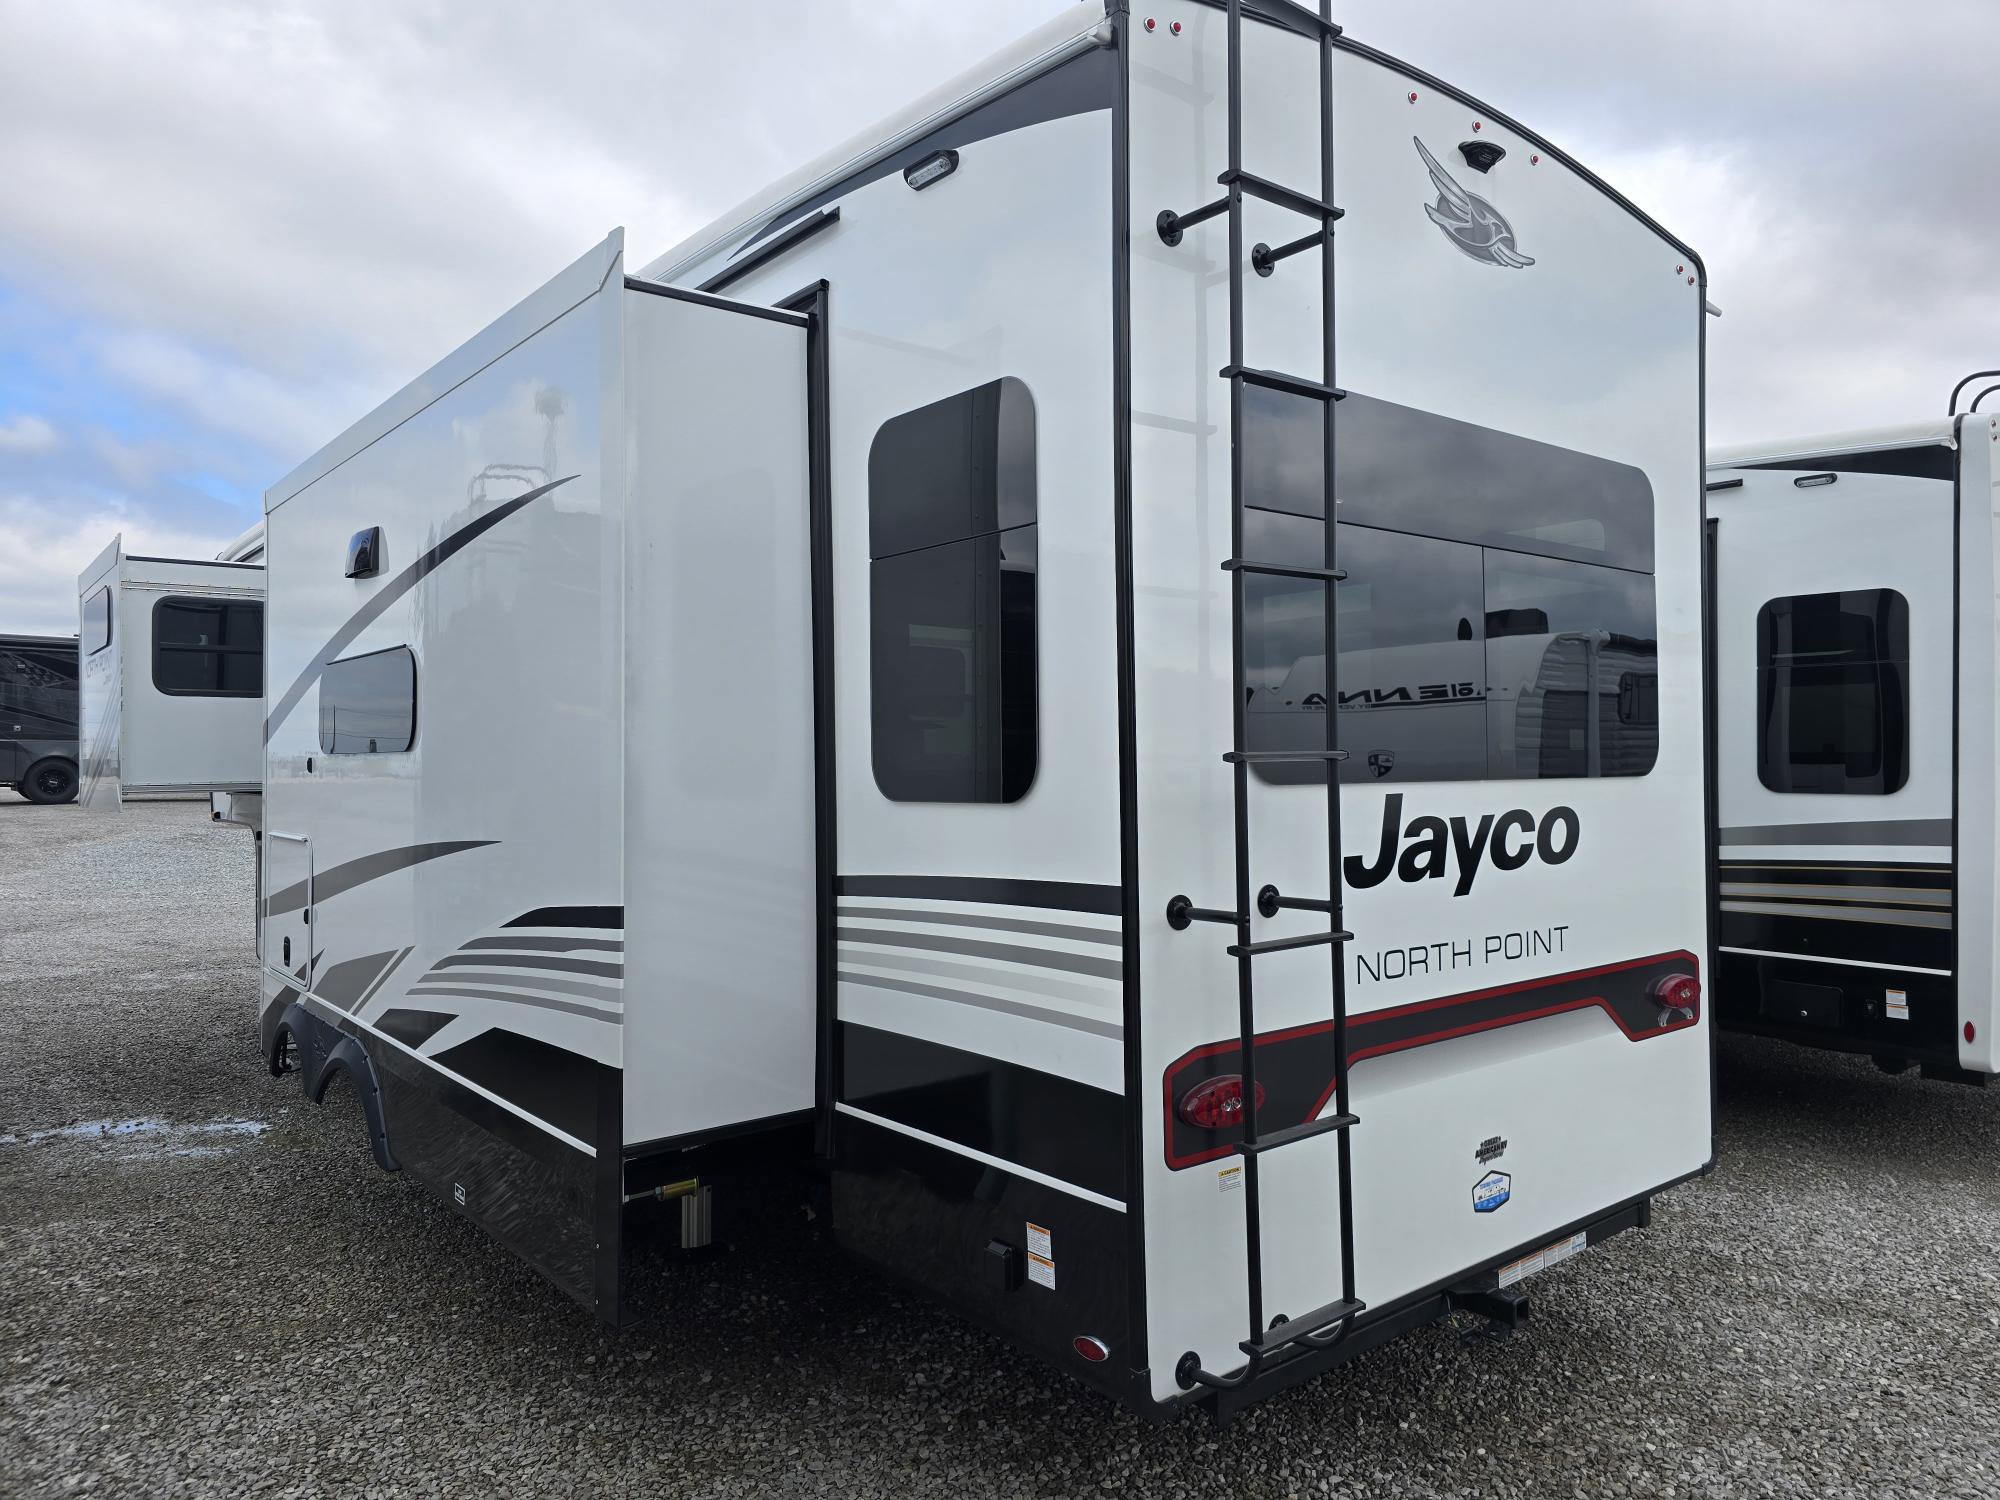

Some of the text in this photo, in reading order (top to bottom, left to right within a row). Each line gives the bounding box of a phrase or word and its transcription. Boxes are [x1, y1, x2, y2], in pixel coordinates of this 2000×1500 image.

[1343, 793, 1580, 897] Jayco
[1357, 926, 1569, 984] NORTH POINT
